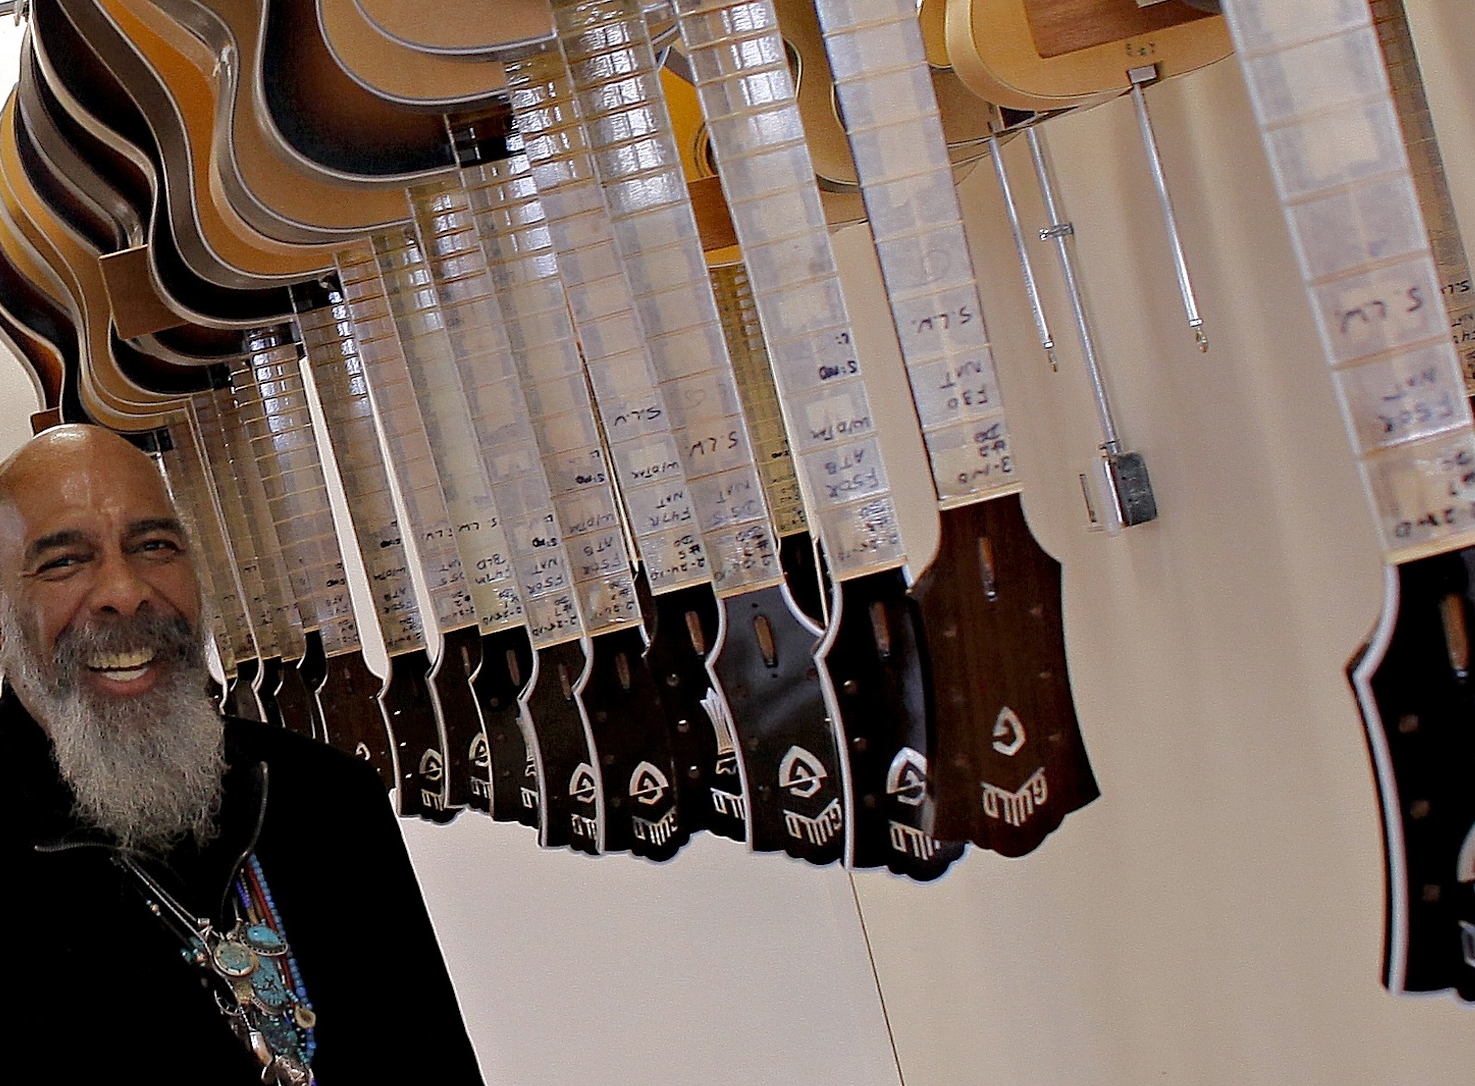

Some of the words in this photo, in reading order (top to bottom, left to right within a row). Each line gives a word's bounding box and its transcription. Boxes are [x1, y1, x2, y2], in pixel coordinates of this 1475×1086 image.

[656, 491, 683, 508] NAT
[477, 554, 505, 570] BLD
[532, 558, 557, 575] NAT
[980, 767, 1049, 827] GUILD
[632, 806, 678, 846] GUILD
[782, 798, 843, 847] GUILD
[889, 820, 941, 861] UILD
